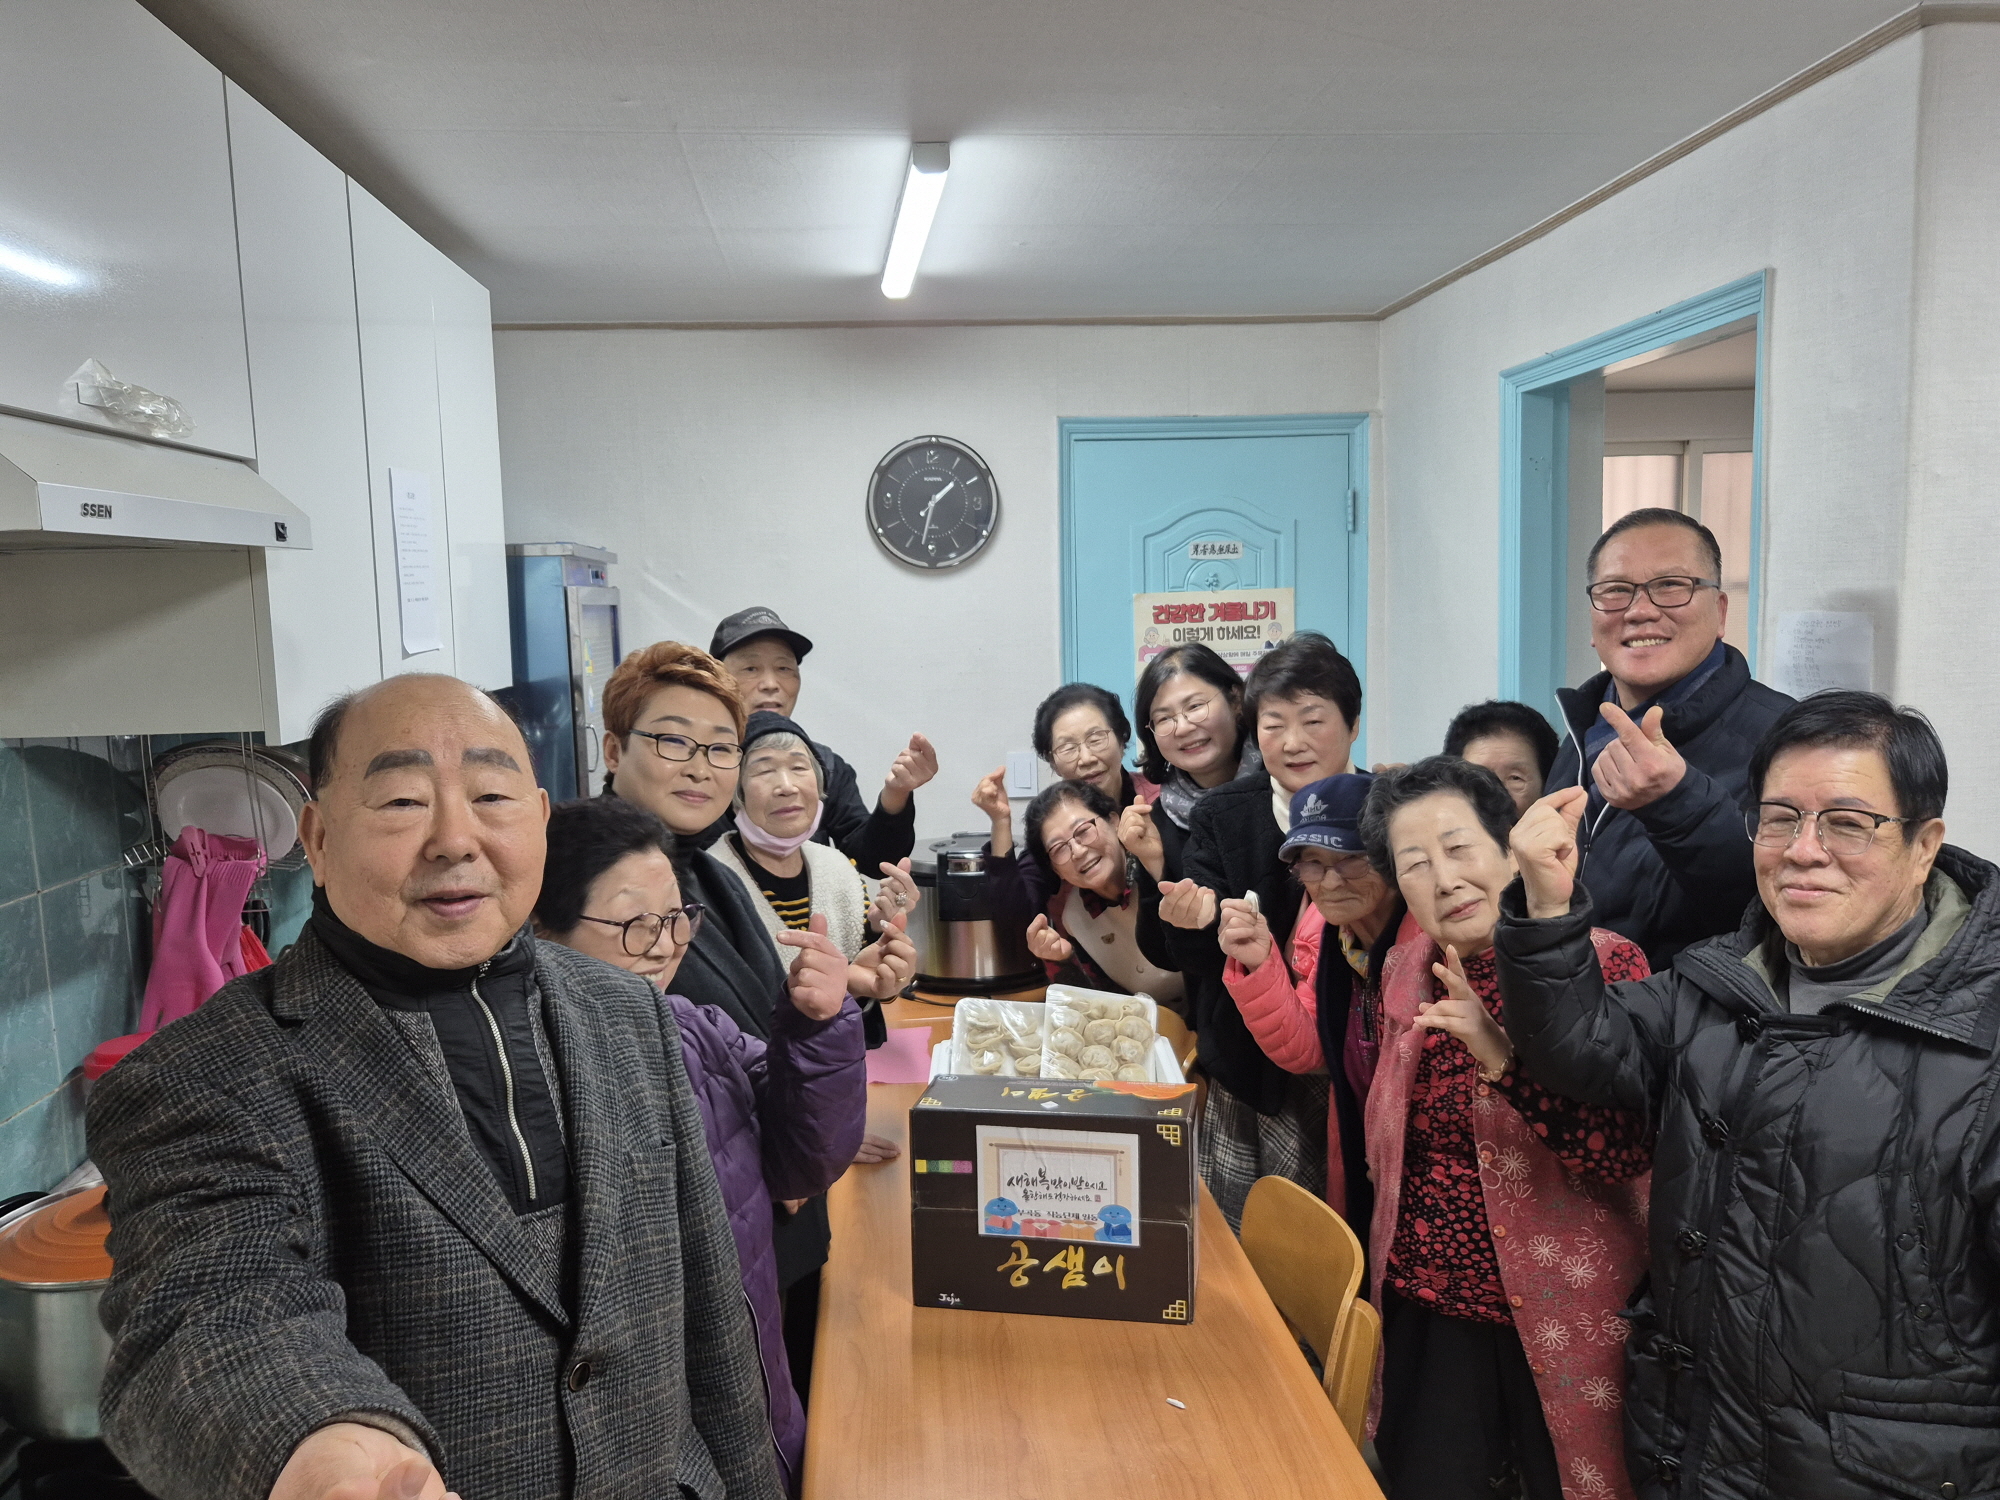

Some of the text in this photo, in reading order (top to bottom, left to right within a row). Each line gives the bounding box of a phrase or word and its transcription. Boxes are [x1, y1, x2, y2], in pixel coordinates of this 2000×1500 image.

[81, 503, 112, 519] SSEN
[1152, 601, 1277, 624] 건강한 겨울나기
[1172, 625, 1261, 643] 이렇게 하세요!
[1006, 1172, 1038, 1188] 새해
[1038, 1167, 1050, 1191] 복
[1070, 1175, 1108, 1191] 받으시고
[938, 1292, 961, 1306] Jeju
